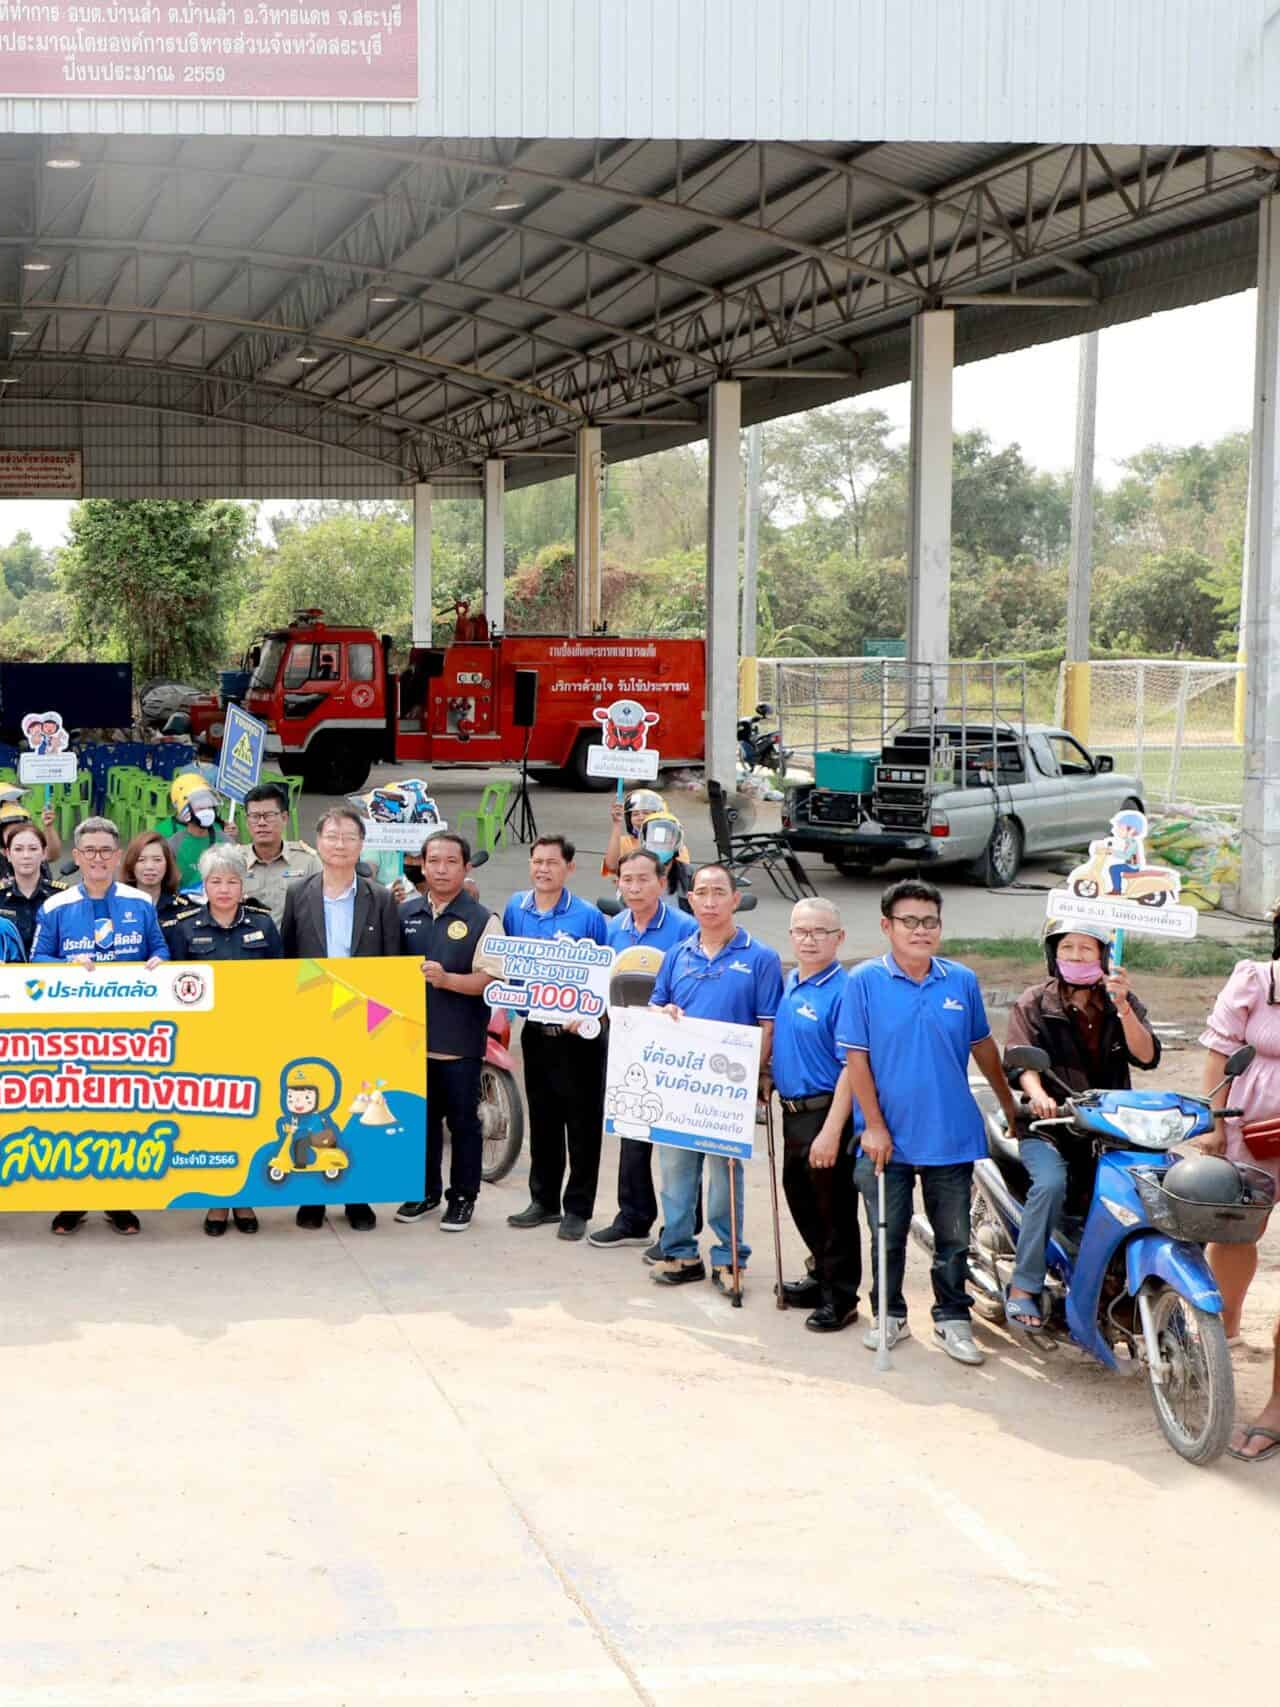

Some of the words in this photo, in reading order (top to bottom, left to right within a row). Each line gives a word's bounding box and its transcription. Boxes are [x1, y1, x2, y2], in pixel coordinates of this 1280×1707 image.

[244, 2, 330, 25] อ.วิหารแดง
[337, 3, 402, 33] จ.สระบุรี
[63, 56, 175, 82] ปีงบประมาณ
[183, 66, 225, 82] 2559
[552, 678, 613, 692] บริการด้วยใจ
[618, 678, 690, 692] รับใช้ประชาชน
[505, 956, 587, 981] ให้ประชาชน
[47, 980, 158, 998] ประกันติดล้อ
[489, 987, 525, 1003] จำนวน
[530, 984, 577, 1009] 100
[582, 992, 599, 1012] ใบ
[642, 1040, 707, 1071] ขี่ต้องใส่
[656, 1070, 749, 1101] ขับต้องคาด
[694, 1102, 745, 1122] ไม่ประมาท
[1, 1127, 173, 1180] สงกรานต์
[171, 1153, 207, 1167] ประจำปี
[207, 1154, 236, 1165] 2566
